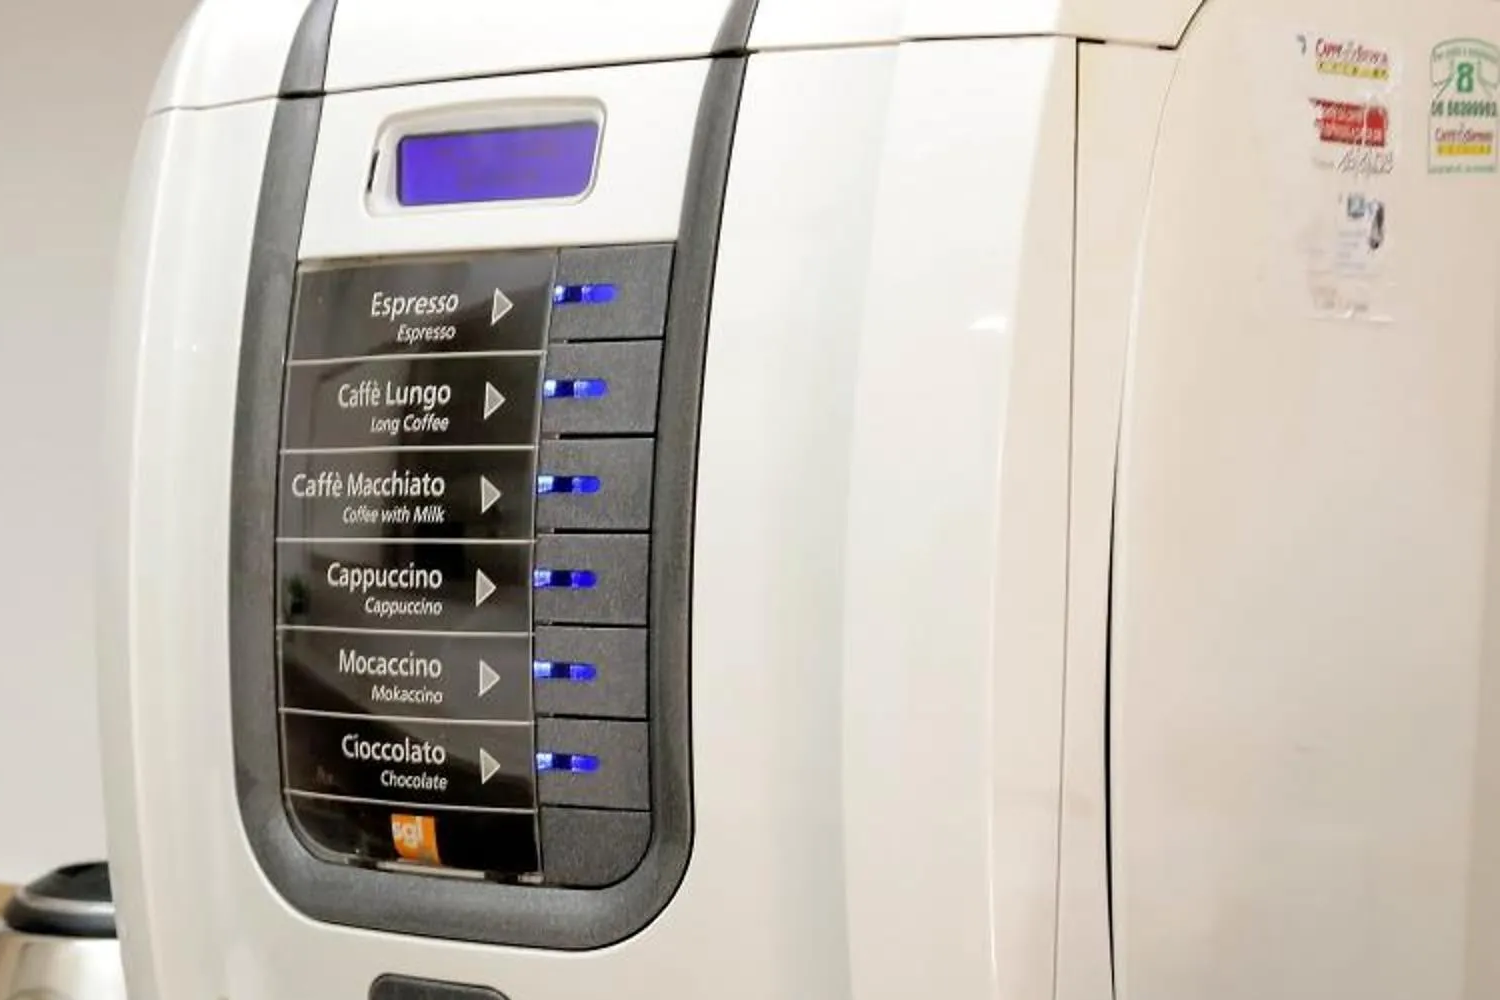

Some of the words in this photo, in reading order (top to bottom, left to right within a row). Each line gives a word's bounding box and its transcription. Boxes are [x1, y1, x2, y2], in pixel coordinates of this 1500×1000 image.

[371, 291, 459, 321] Espresso
[397, 323, 456, 345] Espresso
[338, 380, 381, 408] Caffè
[385, 380, 451, 411] Lungo
[370, 417, 401, 436] Long
[403, 413, 449, 432] Coffee
[291, 471, 343, 498] Caffè
[347, 470, 445, 497] Macchiato
[342, 505, 379, 524] Coffee
[381, 505, 411, 523] with
[413, 505, 445, 523] Milk
[327, 562, 443, 593] Cappuccino
[364, 596, 443, 618] Cappuccino
[339, 649, 443, 678] Mocaccino
[371, 684, 443, 704] Mokaccino
[341, 734, 446, 765] Cioccolato
[380, 769, 449, 791] Chocolate
